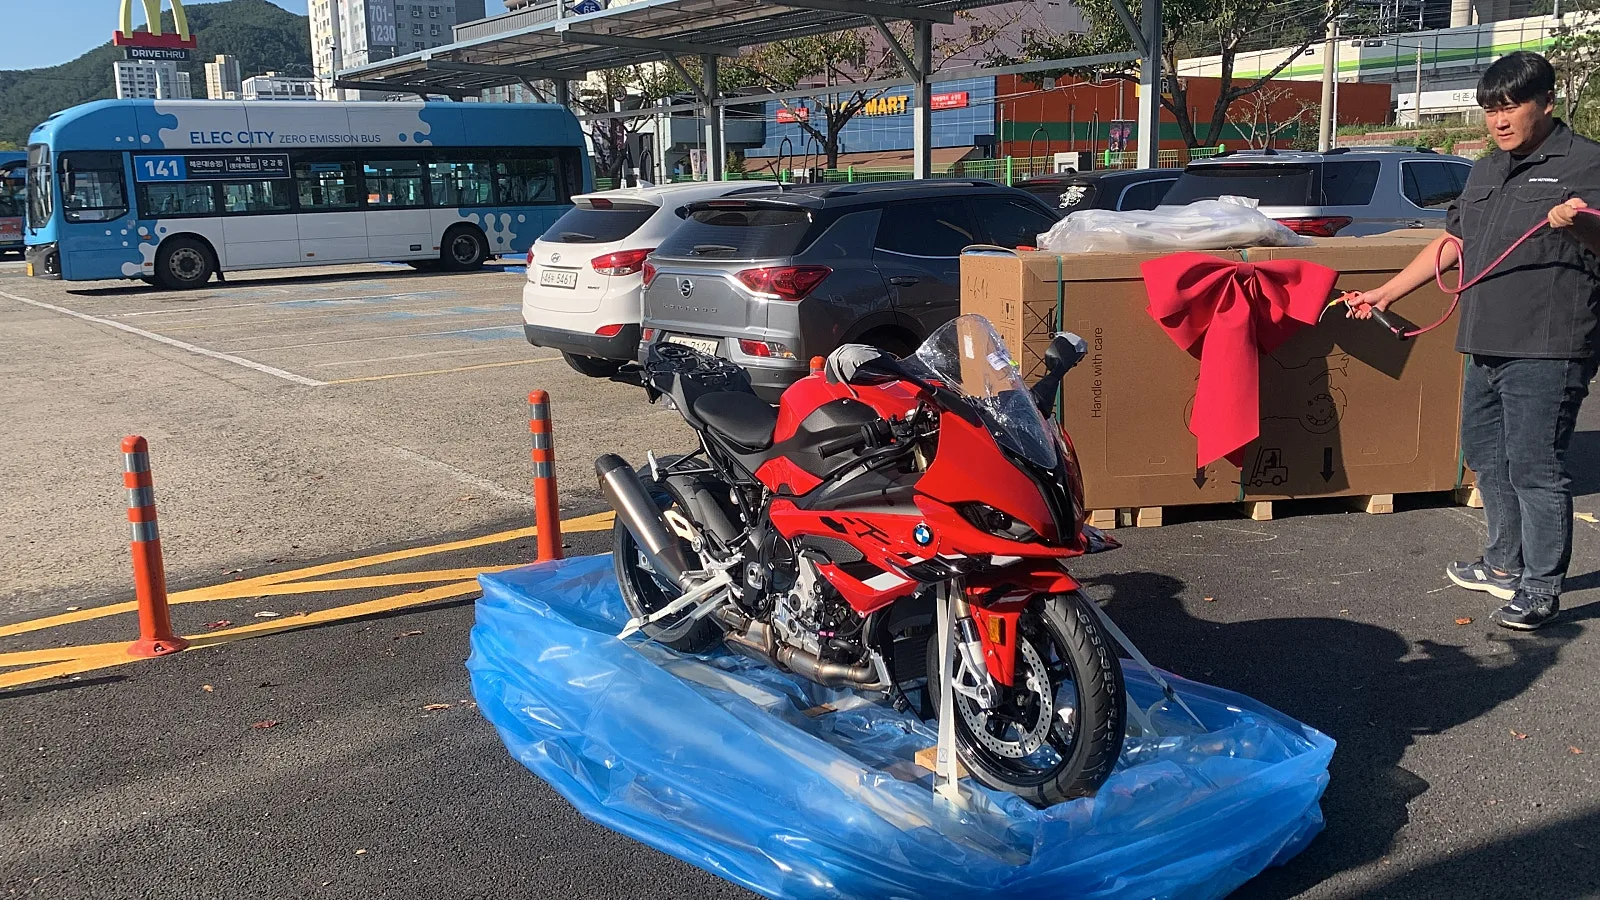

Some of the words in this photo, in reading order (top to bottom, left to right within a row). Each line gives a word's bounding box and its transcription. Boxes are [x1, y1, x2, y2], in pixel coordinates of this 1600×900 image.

[371, 25, 396, 42] 1230
[865, 95, 909, 115] MART
[190, 131, 233, 144] ELEC
[237, 131, 275, 144] CITY
[279, 134, 307, 144] ZERO
[309, 134, 359, 143] EMISSION
[361, 134, 381, 143] BUS
[144, 160, 179, 177] 141
[1094, 327, 1103, 351] care
[1092, 354, 1102, 377] with
[1091, 379, 1102, 418] Handle
